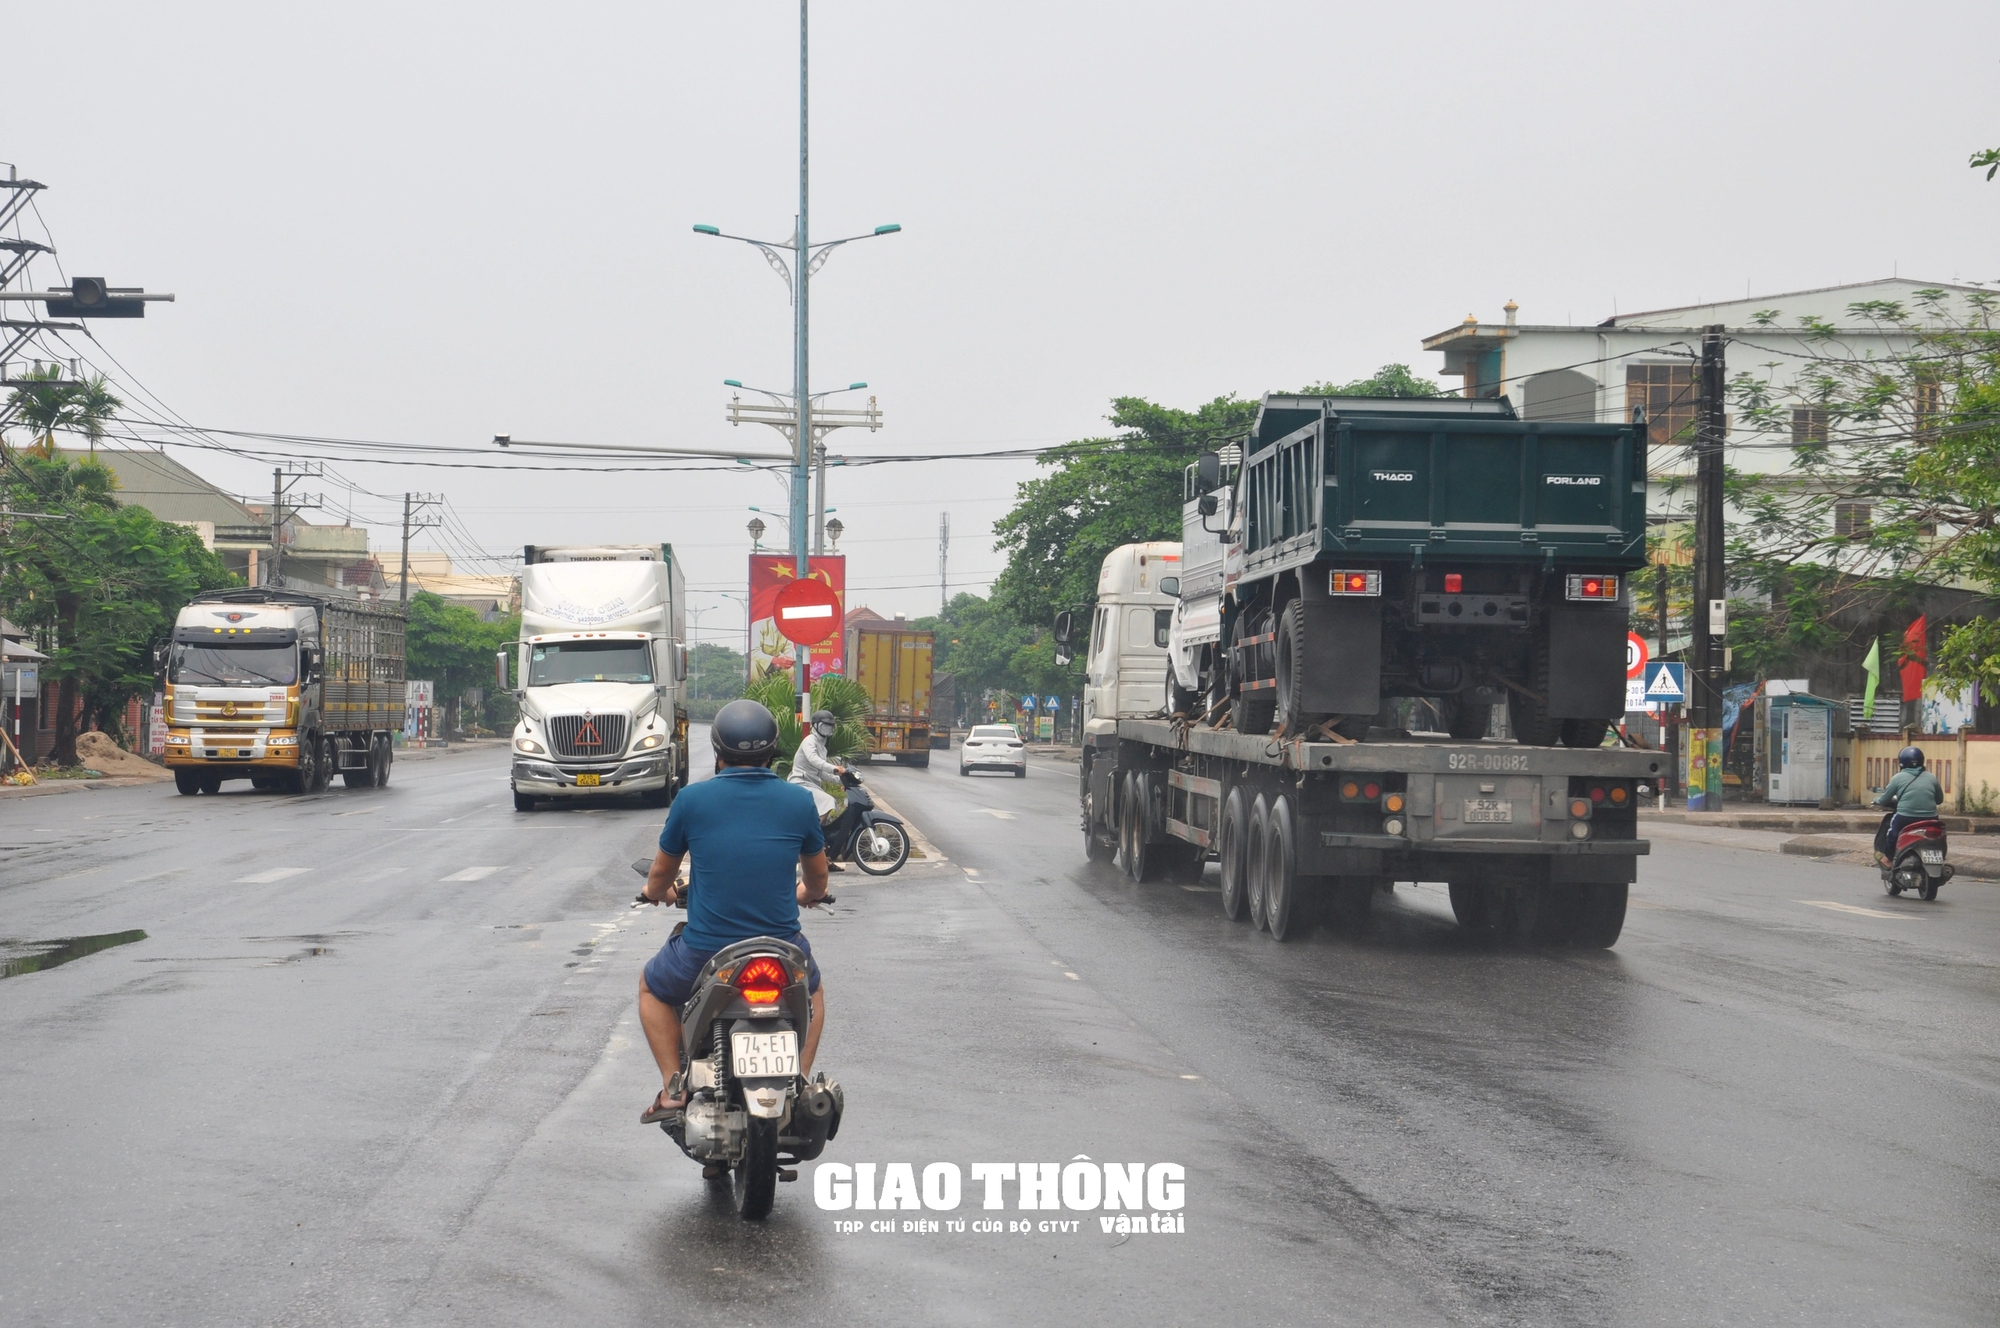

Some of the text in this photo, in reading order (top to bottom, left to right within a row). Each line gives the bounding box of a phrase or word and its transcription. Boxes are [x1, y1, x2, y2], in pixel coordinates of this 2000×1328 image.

[1373, 473, 1413, 481] THACO
[1546, 477, 1600, 485] FORLAND
[1448, 753, 1529, 771] 92R-00882
[1477, 800, 1498, 810] 92R
[1469, 812, 1507, 821] 008.82
[742, 1035, 787, 1054] 74-E1
[738, 1055, 795, 1075] 051.07
